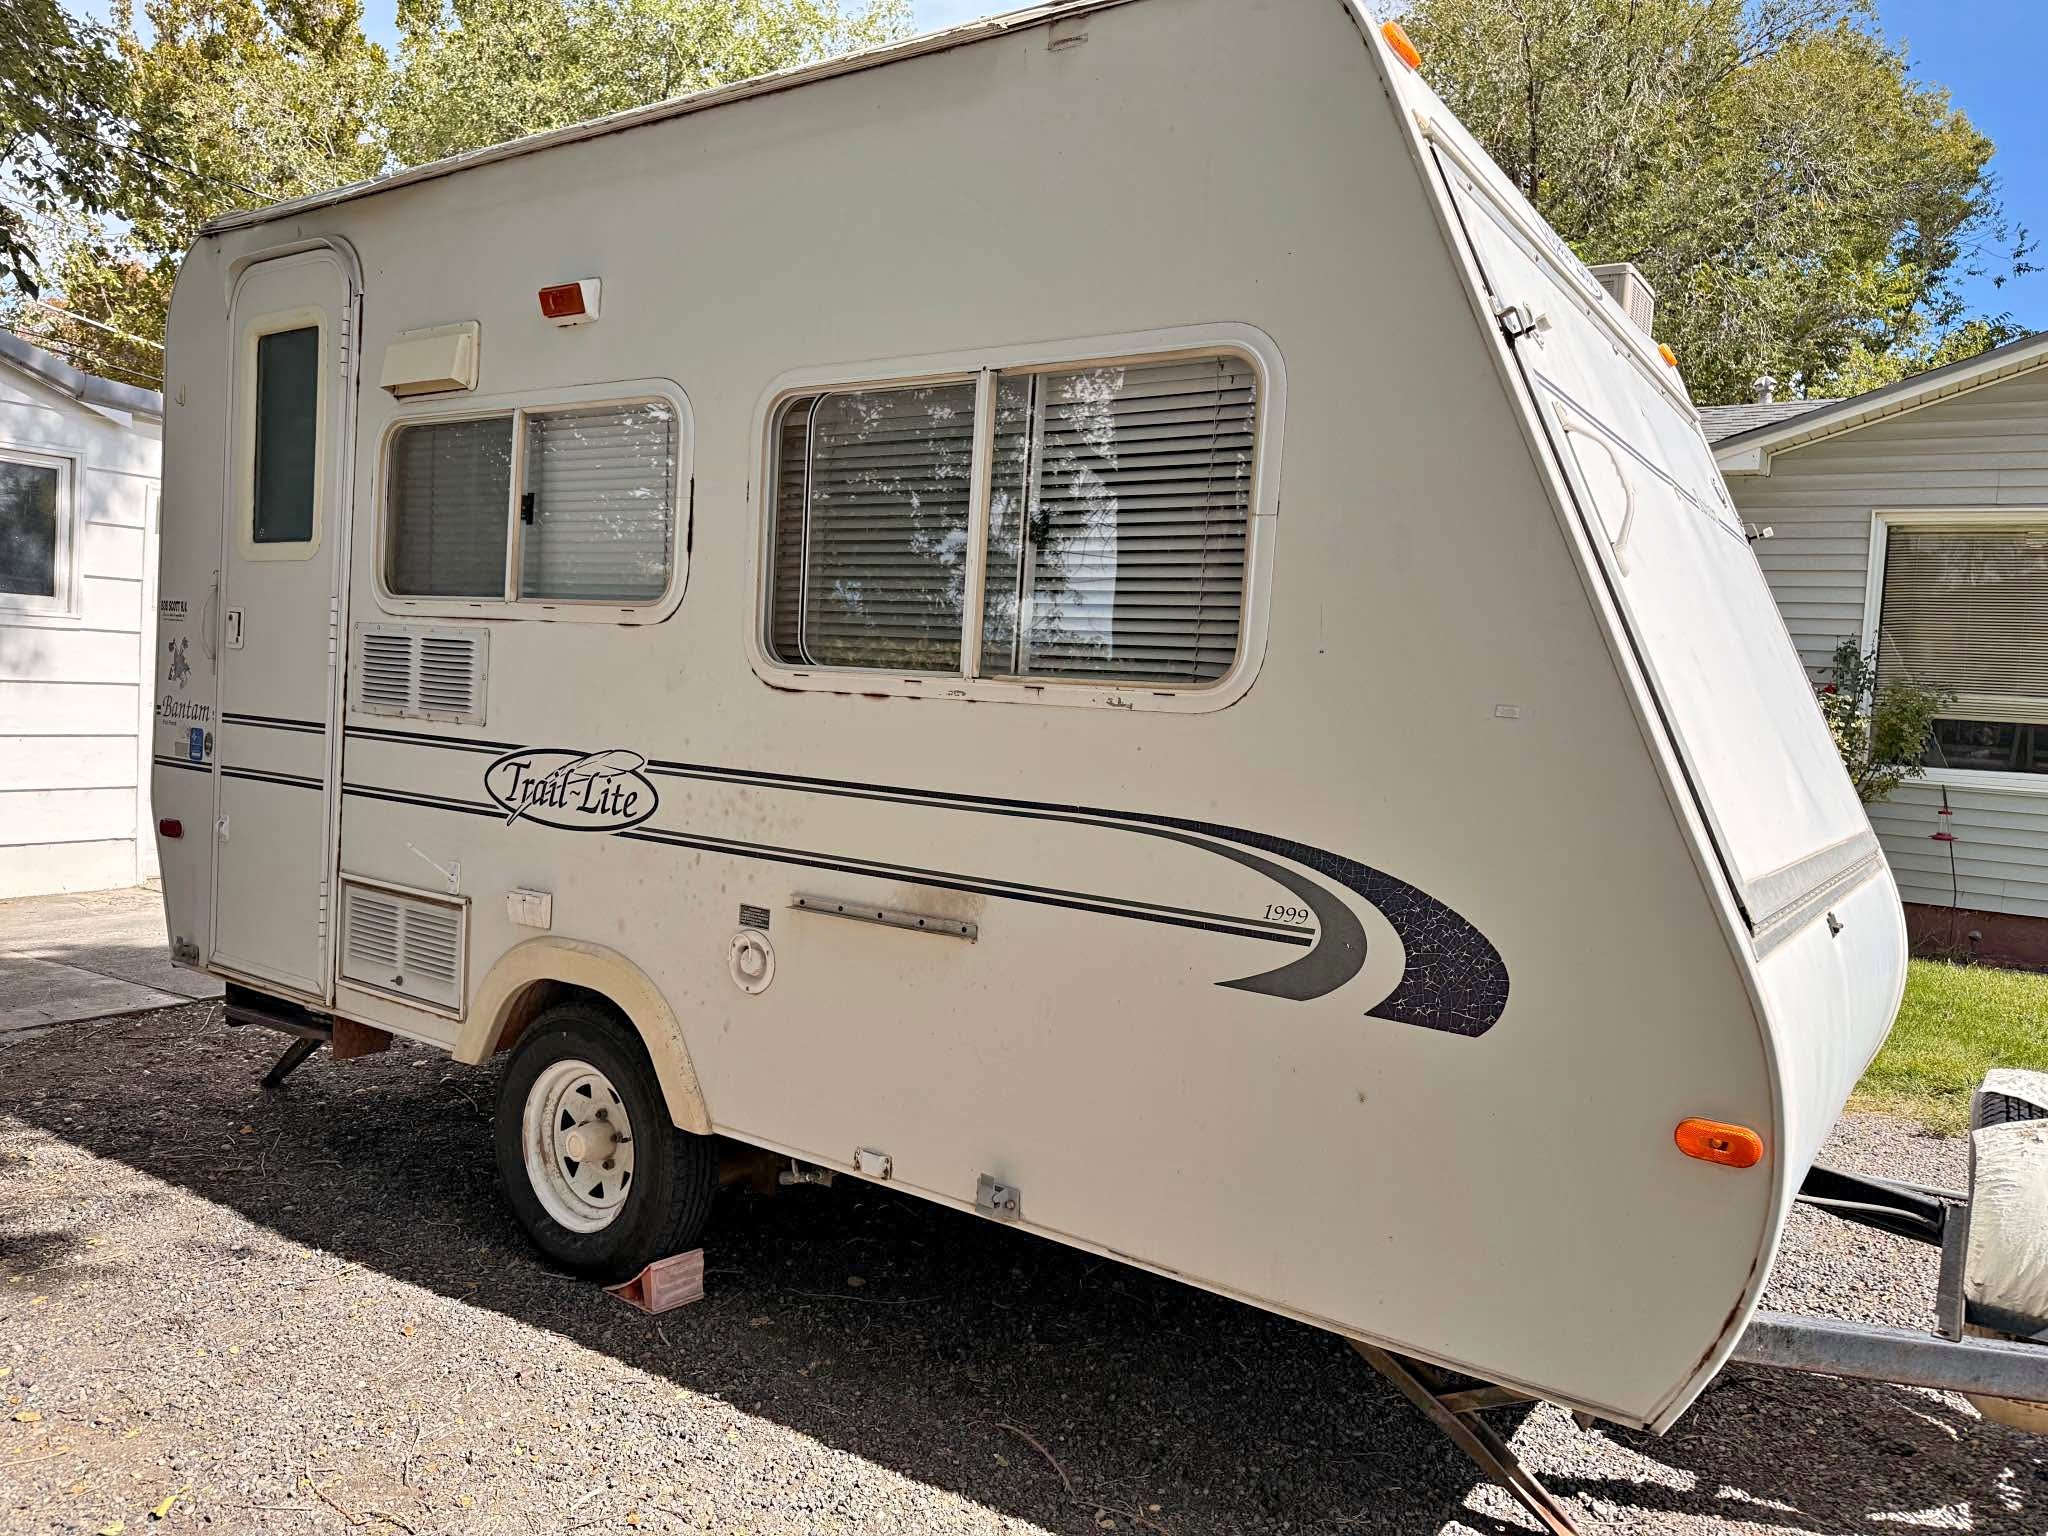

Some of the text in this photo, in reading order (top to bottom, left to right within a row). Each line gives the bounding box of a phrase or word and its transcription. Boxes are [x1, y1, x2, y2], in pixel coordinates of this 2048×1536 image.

[169, 600, 180, 612] SCOTT
[162, 695, 210, 722] Bantam
[1264, 904, 1309, 925] 1999
